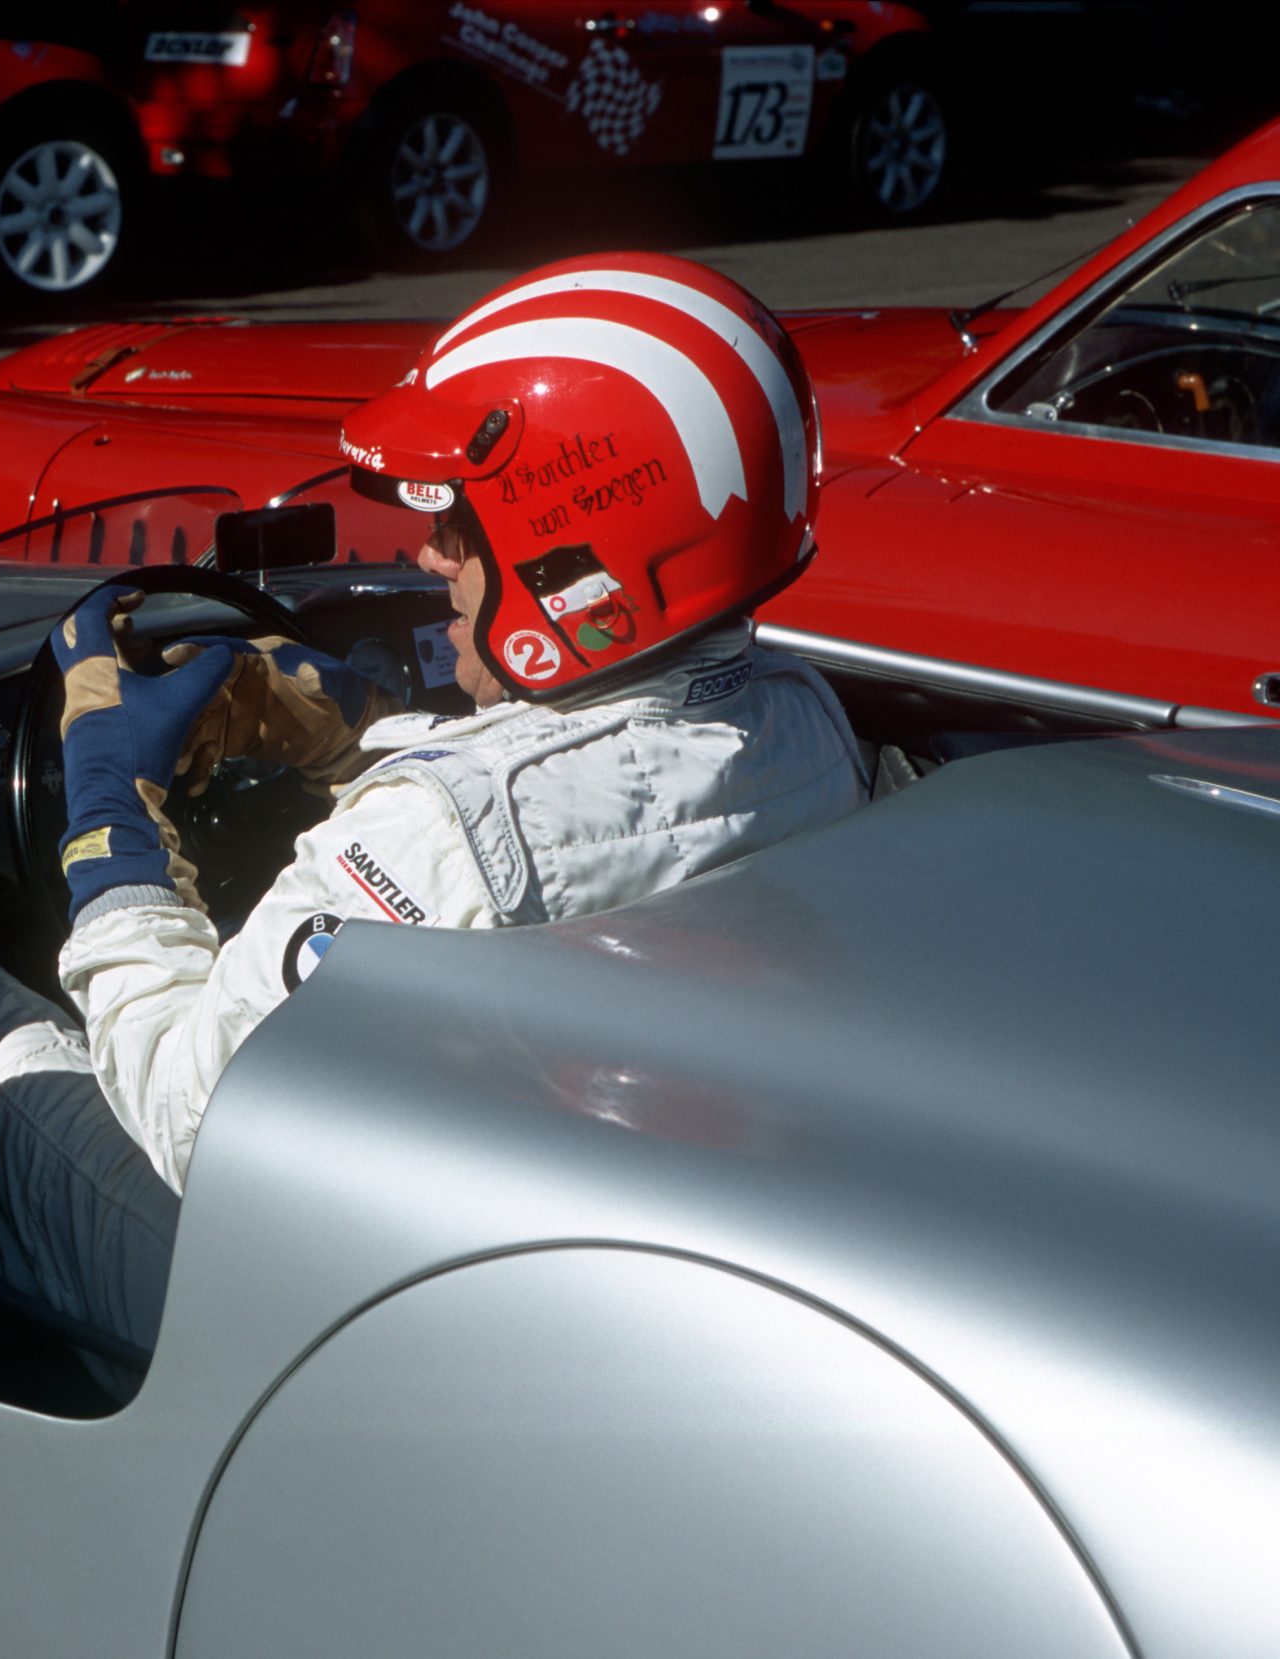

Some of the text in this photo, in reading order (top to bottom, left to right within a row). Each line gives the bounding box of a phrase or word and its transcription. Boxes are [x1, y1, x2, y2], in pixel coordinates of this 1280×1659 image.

[716, 81, 788, 146] 173
[406, 483, 443, 500] BELL
[410, 496, 437, 506] HELMETS
[512, 635, 557, 677] 2
[690, 667, 750, 703] sparco
[344, 842, 426, 926] SANDTLER
